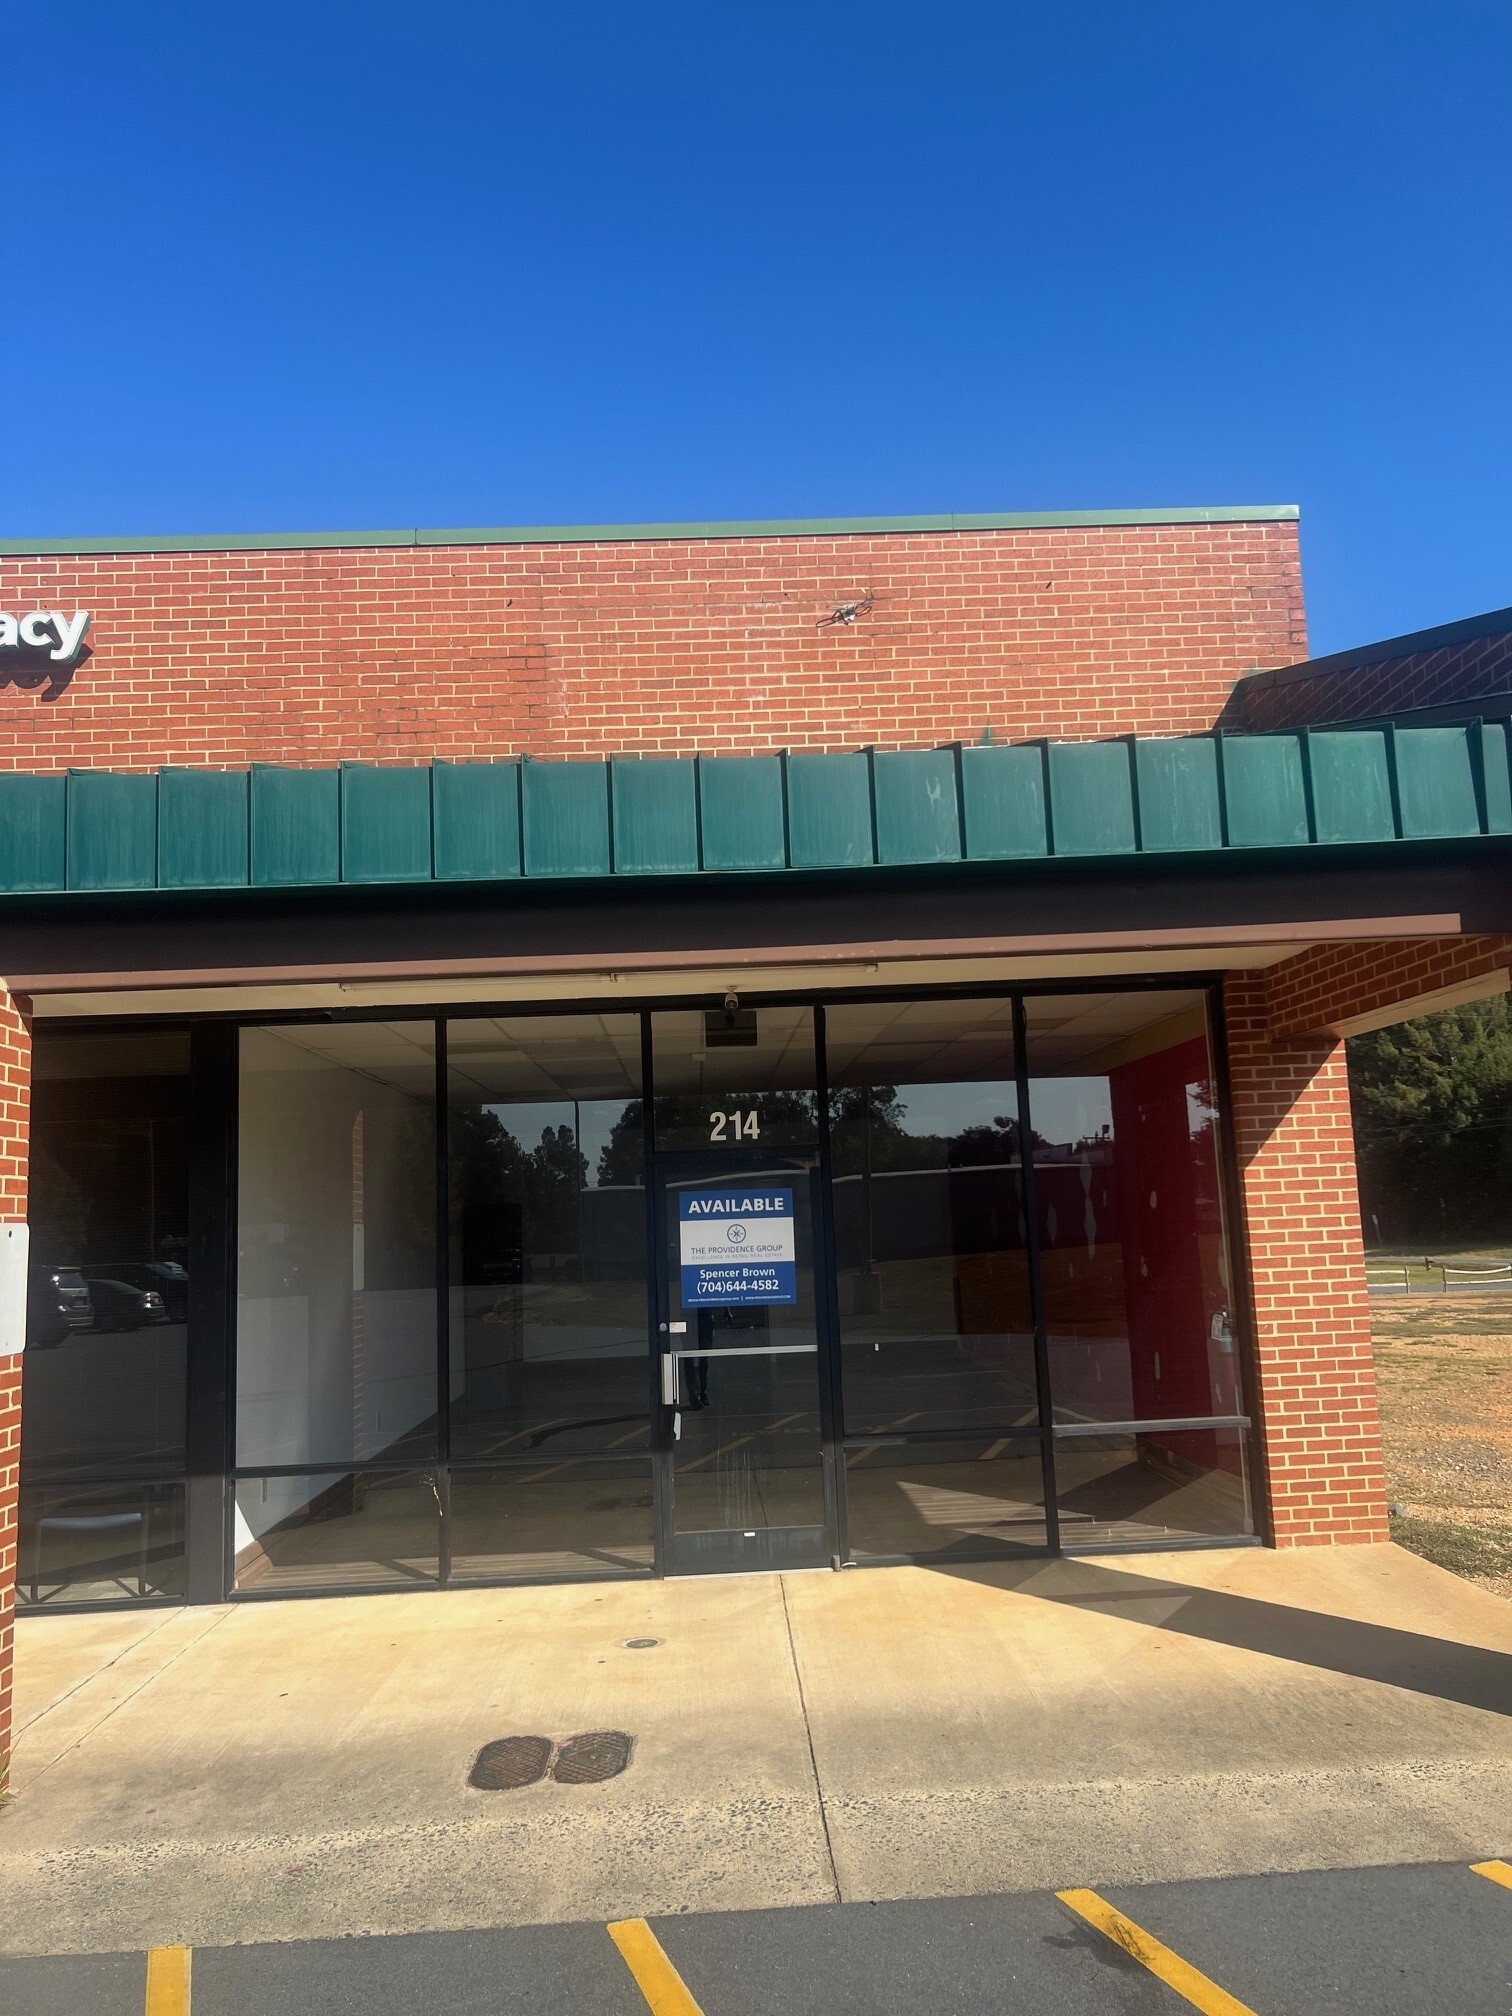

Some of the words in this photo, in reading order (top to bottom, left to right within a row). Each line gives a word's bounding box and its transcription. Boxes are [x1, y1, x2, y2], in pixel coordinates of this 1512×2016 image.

[709, 1111, 760, 1141] 214
[688, 1198, 784, 1213] AVAILABLE
[691, 1247, 706, 1255] THE
[708, 1245, 754, 1254] PROVIDENCE
[756, 1244, 783, 1252] GROUP
[700, 1269, 740, 1280] Spencer
[742, 1268, 775, 1277] Brown
[697, 1279, 779, 1294] (704)644-4582
